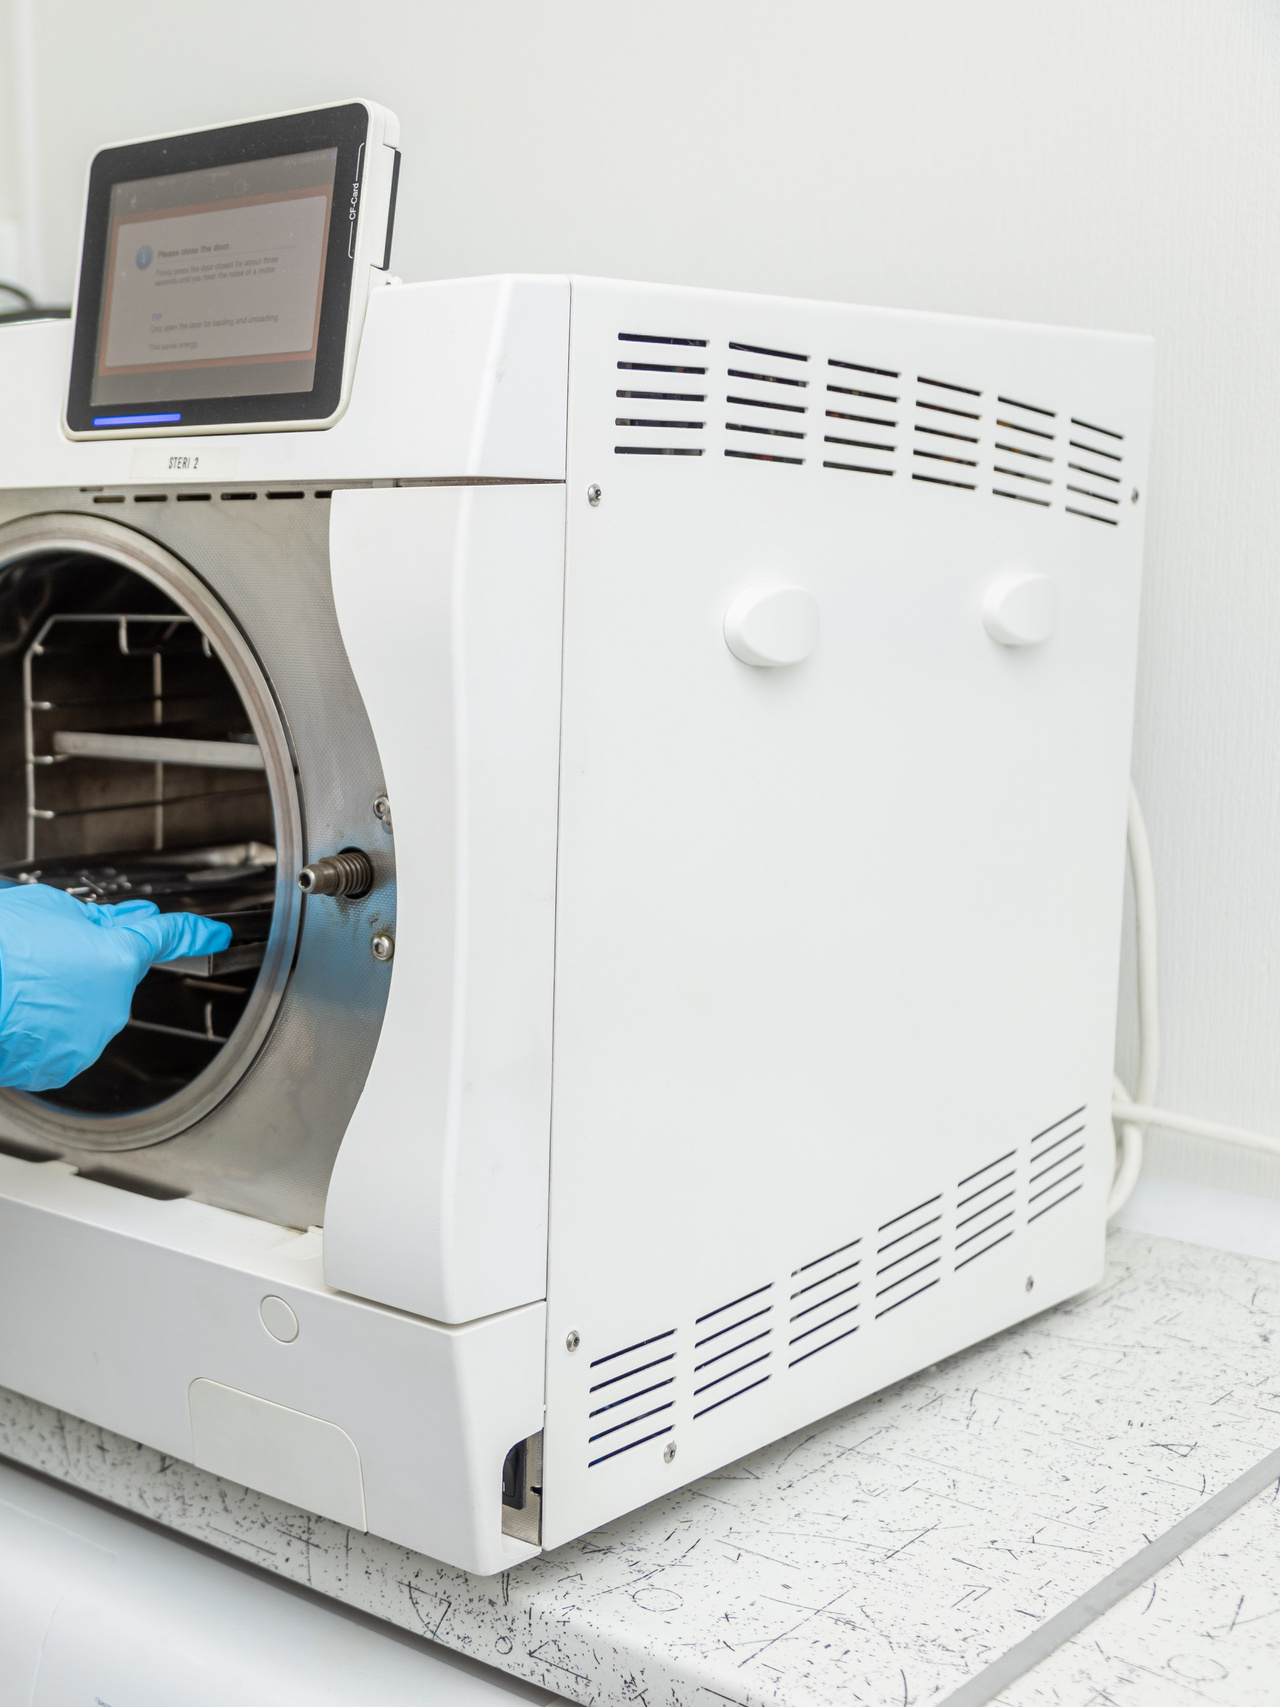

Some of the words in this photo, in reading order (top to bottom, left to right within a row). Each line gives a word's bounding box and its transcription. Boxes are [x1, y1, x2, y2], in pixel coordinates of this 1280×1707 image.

[349, 183, 360, 220] CF-Card
[158, 250, 179, 258] Please
[181, 247, 199, 256] close
[200, 244, 212, 253] the
[190, 265, 200, 273] the
[200, 263, 214, 272] door
[244, 258, 262, 266] about
[263, 256, 279, 264] three
[192, 276, 202, 284] you
[203, 273, 217, 281] hear
[218, 271, 227, 279] the
[245, 268, 252, 276] of
[189, 321, 202, 329] door
[203, 319, 211, 327] for
[212, 317, 235, 327] loading
[235, 316, 248, 324] and
[168, 456, 191, 469] STERI
[193, 456, 200, 469] 2
